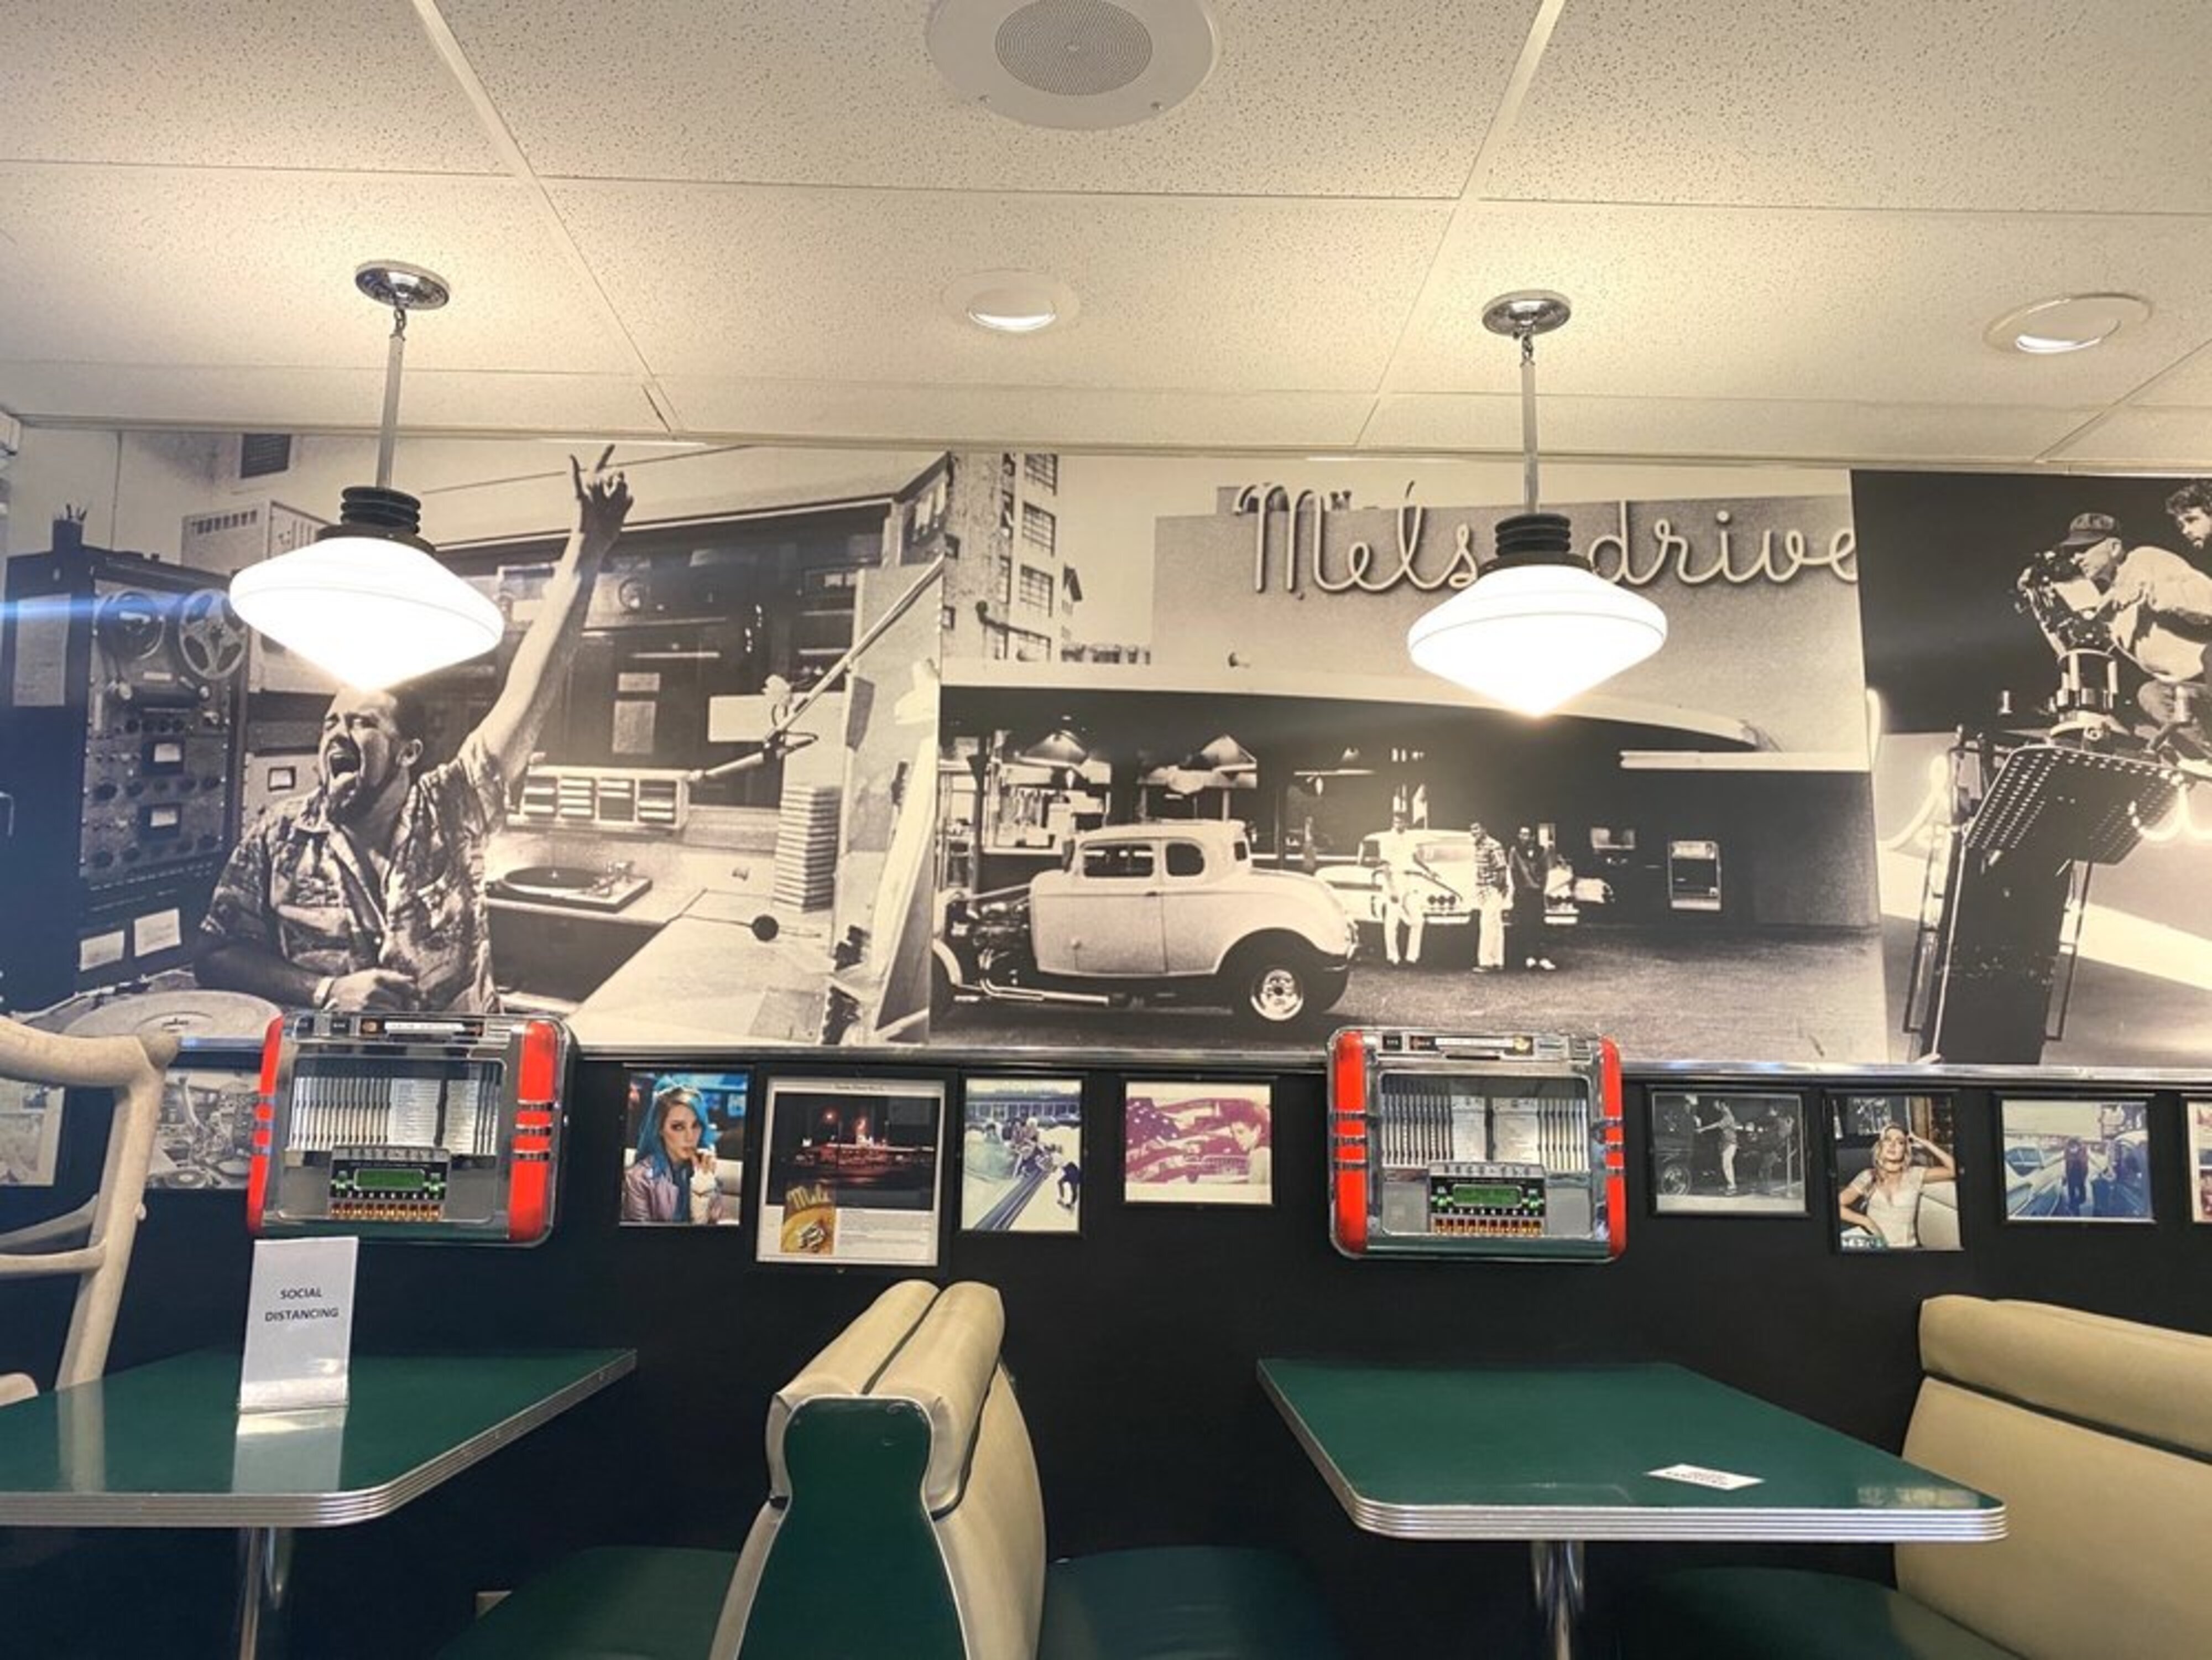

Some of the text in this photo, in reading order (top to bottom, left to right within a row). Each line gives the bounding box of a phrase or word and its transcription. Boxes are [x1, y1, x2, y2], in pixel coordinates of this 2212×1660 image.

[1589, 496, 1858, 584] drive
[280, 1288, 321, 1299] SOCIAL
[265, 1308, 338, 1321] DISTANCING
